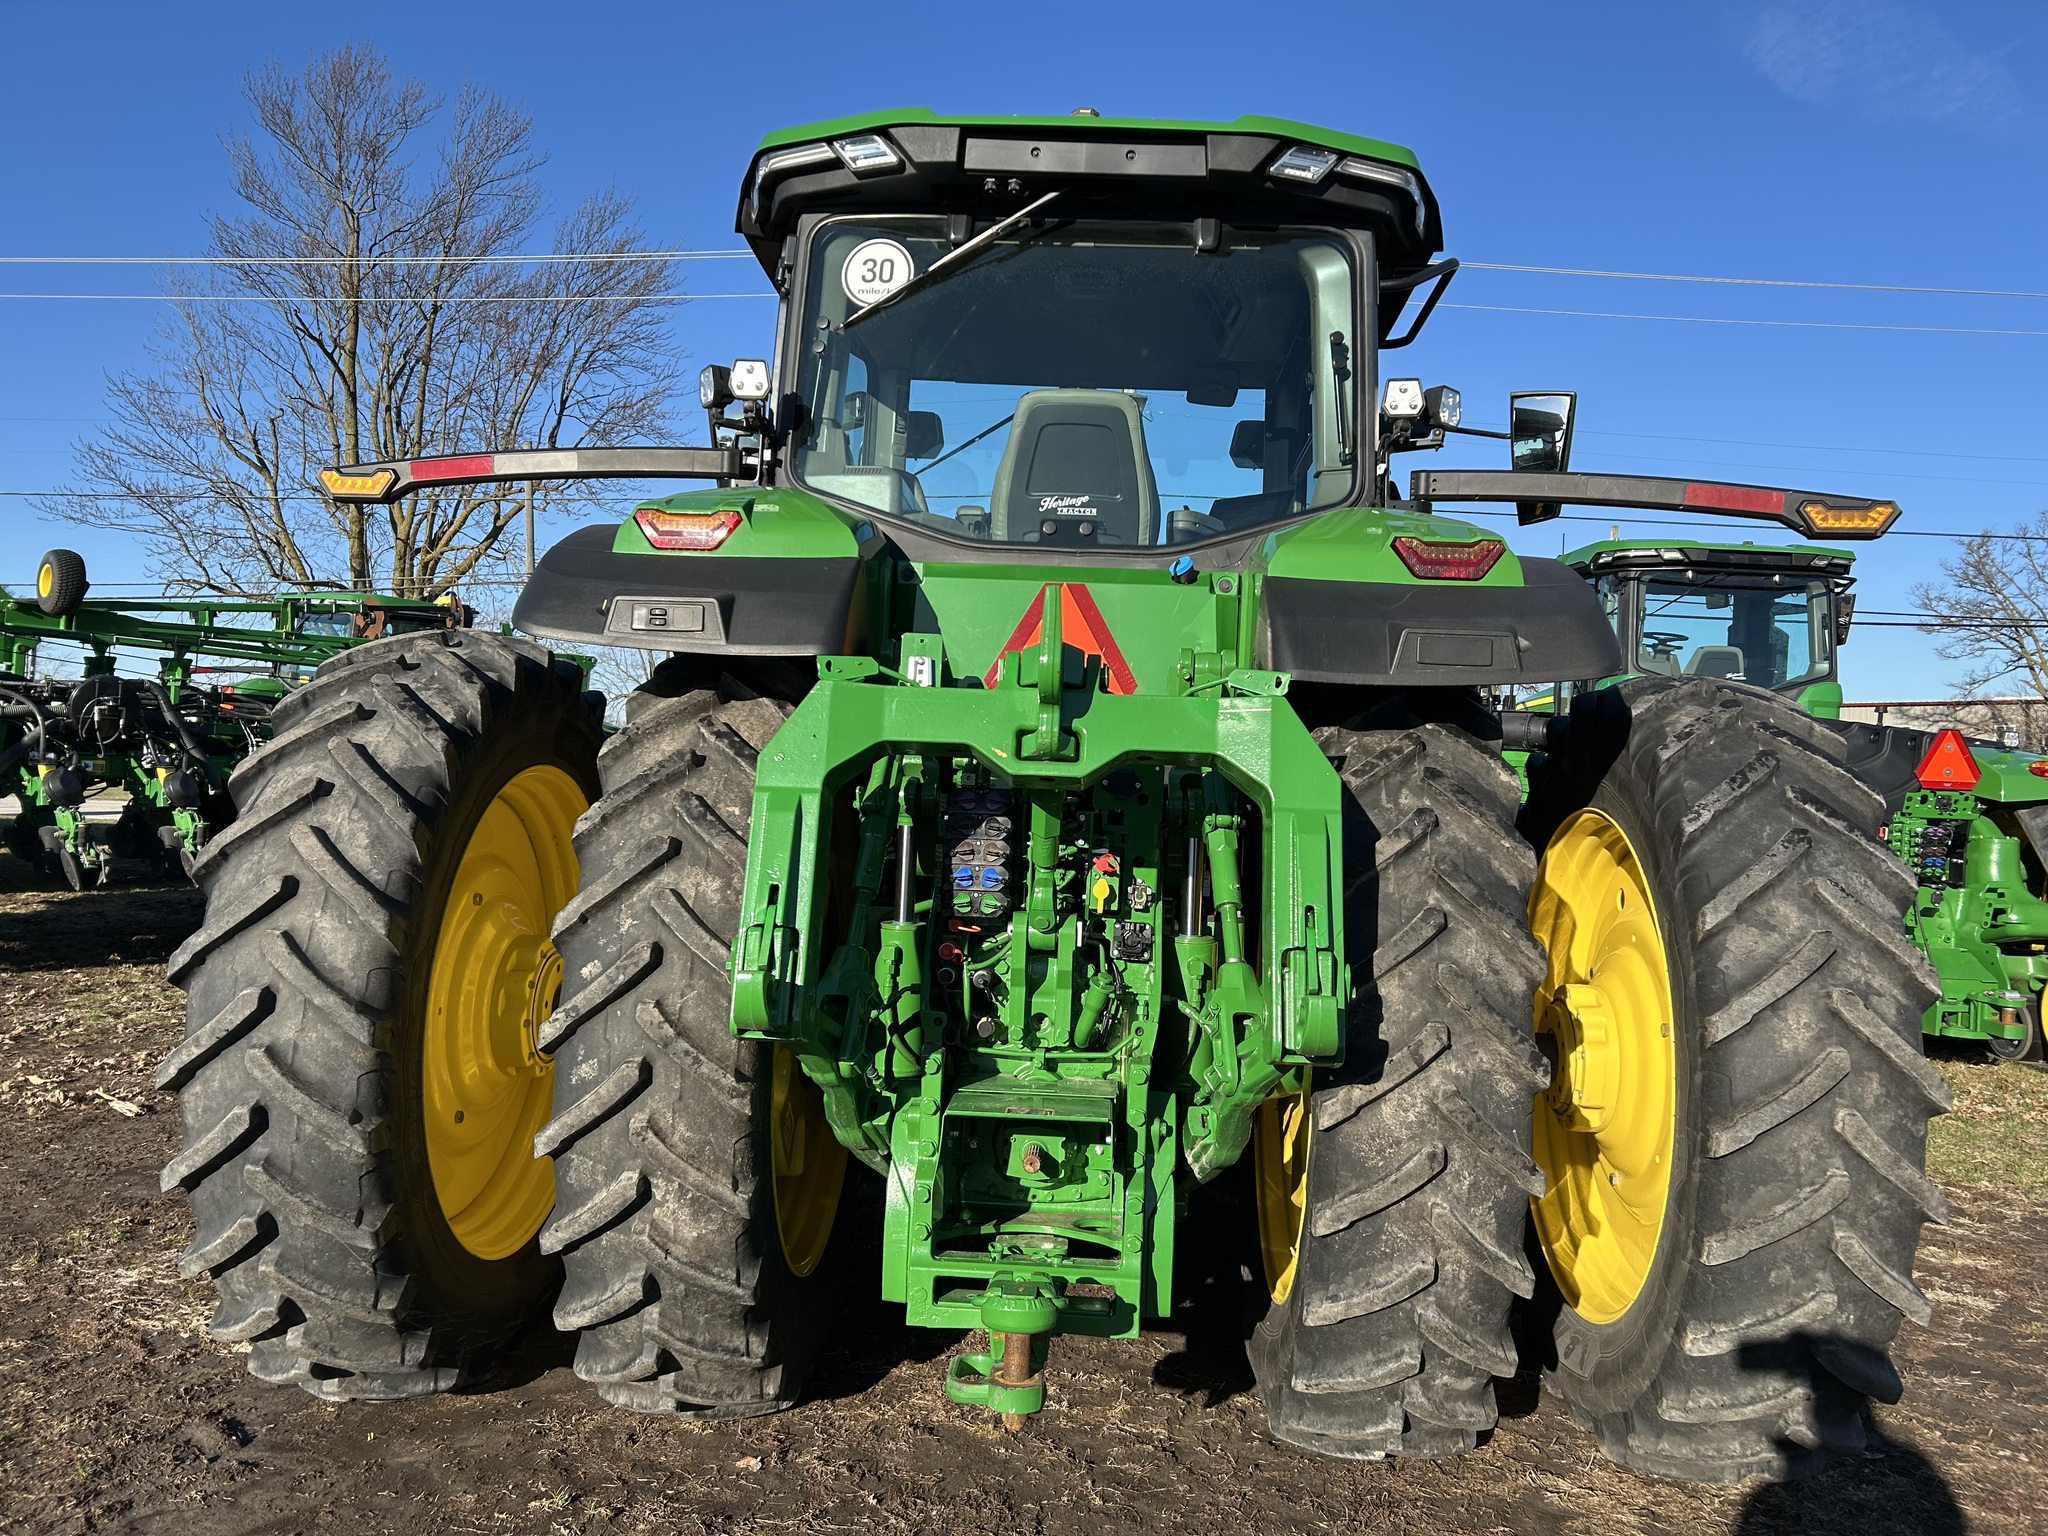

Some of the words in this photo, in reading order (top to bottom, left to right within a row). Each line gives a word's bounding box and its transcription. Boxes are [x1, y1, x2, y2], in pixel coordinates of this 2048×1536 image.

[861, 258, 895, 284] 30
[1038, 495, 1090, 512] Heritage
[1056, 507, 1097, 516] TRACTOR
